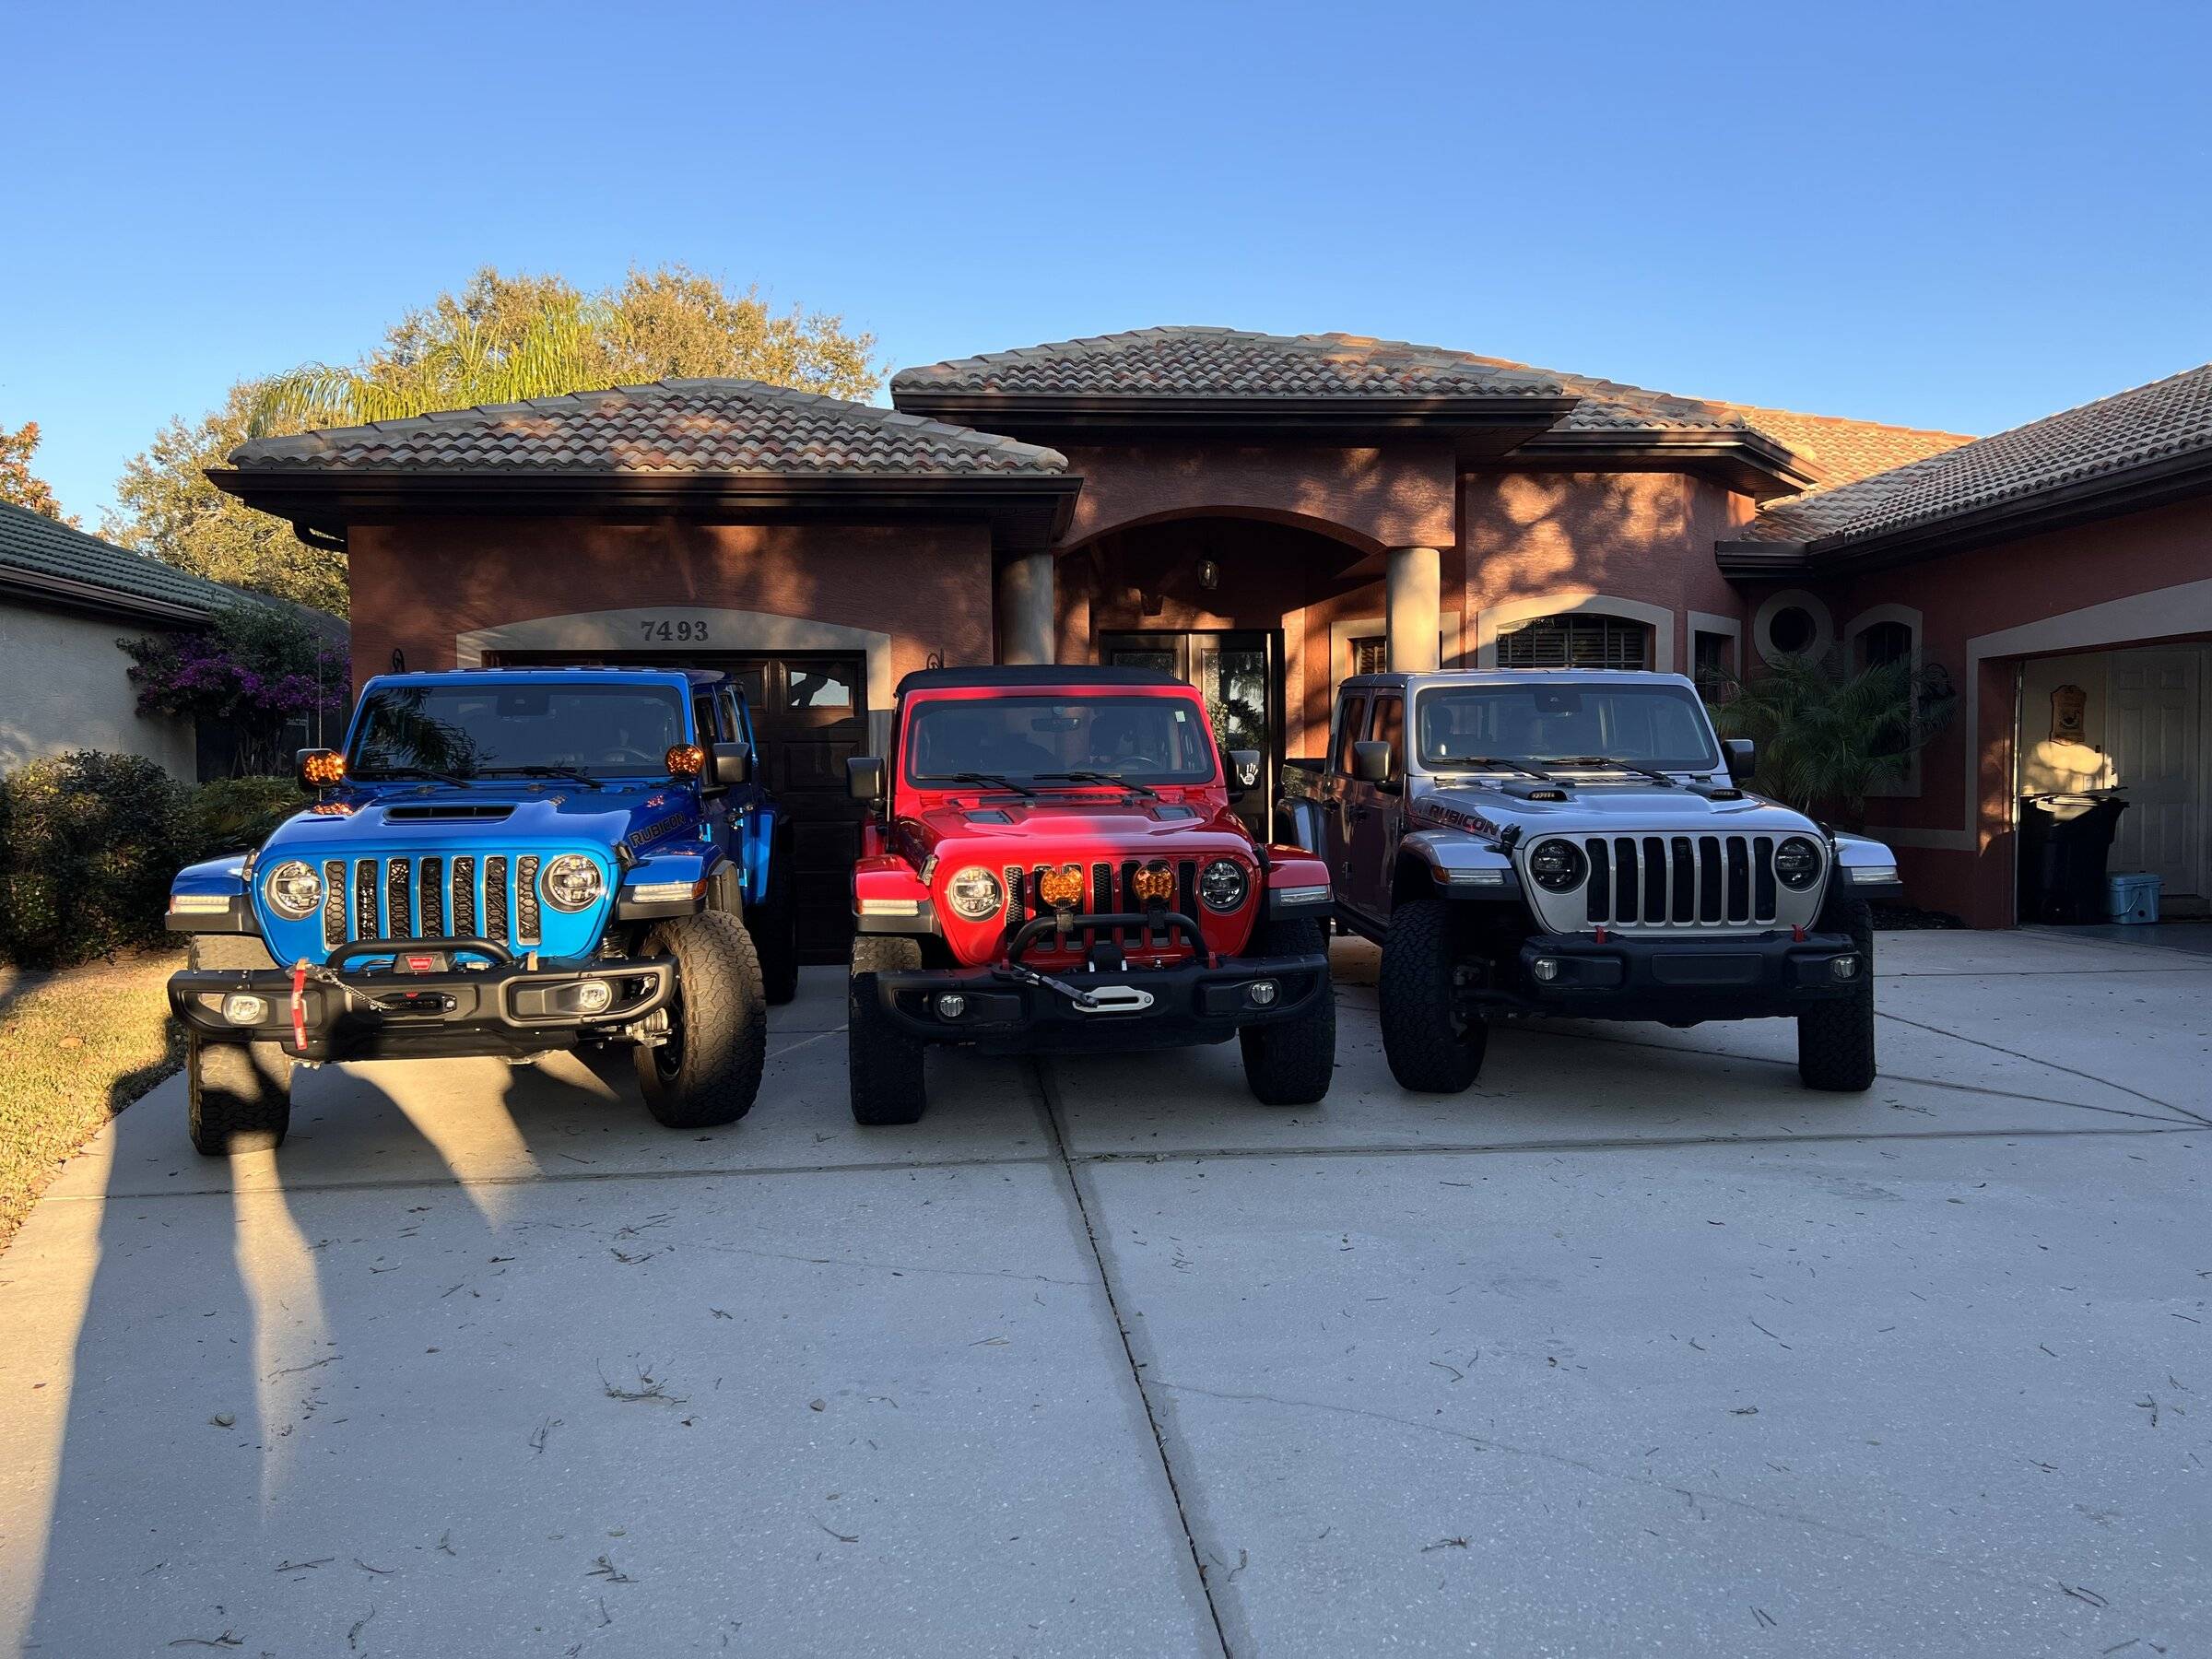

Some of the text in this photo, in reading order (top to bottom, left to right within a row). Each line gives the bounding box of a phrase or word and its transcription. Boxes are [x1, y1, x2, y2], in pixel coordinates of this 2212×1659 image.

[641, 620, 709, 641] 7493
[629, 812, 686, 848] RUBICON
[1429, 804, 1500, 836] RUBICON
